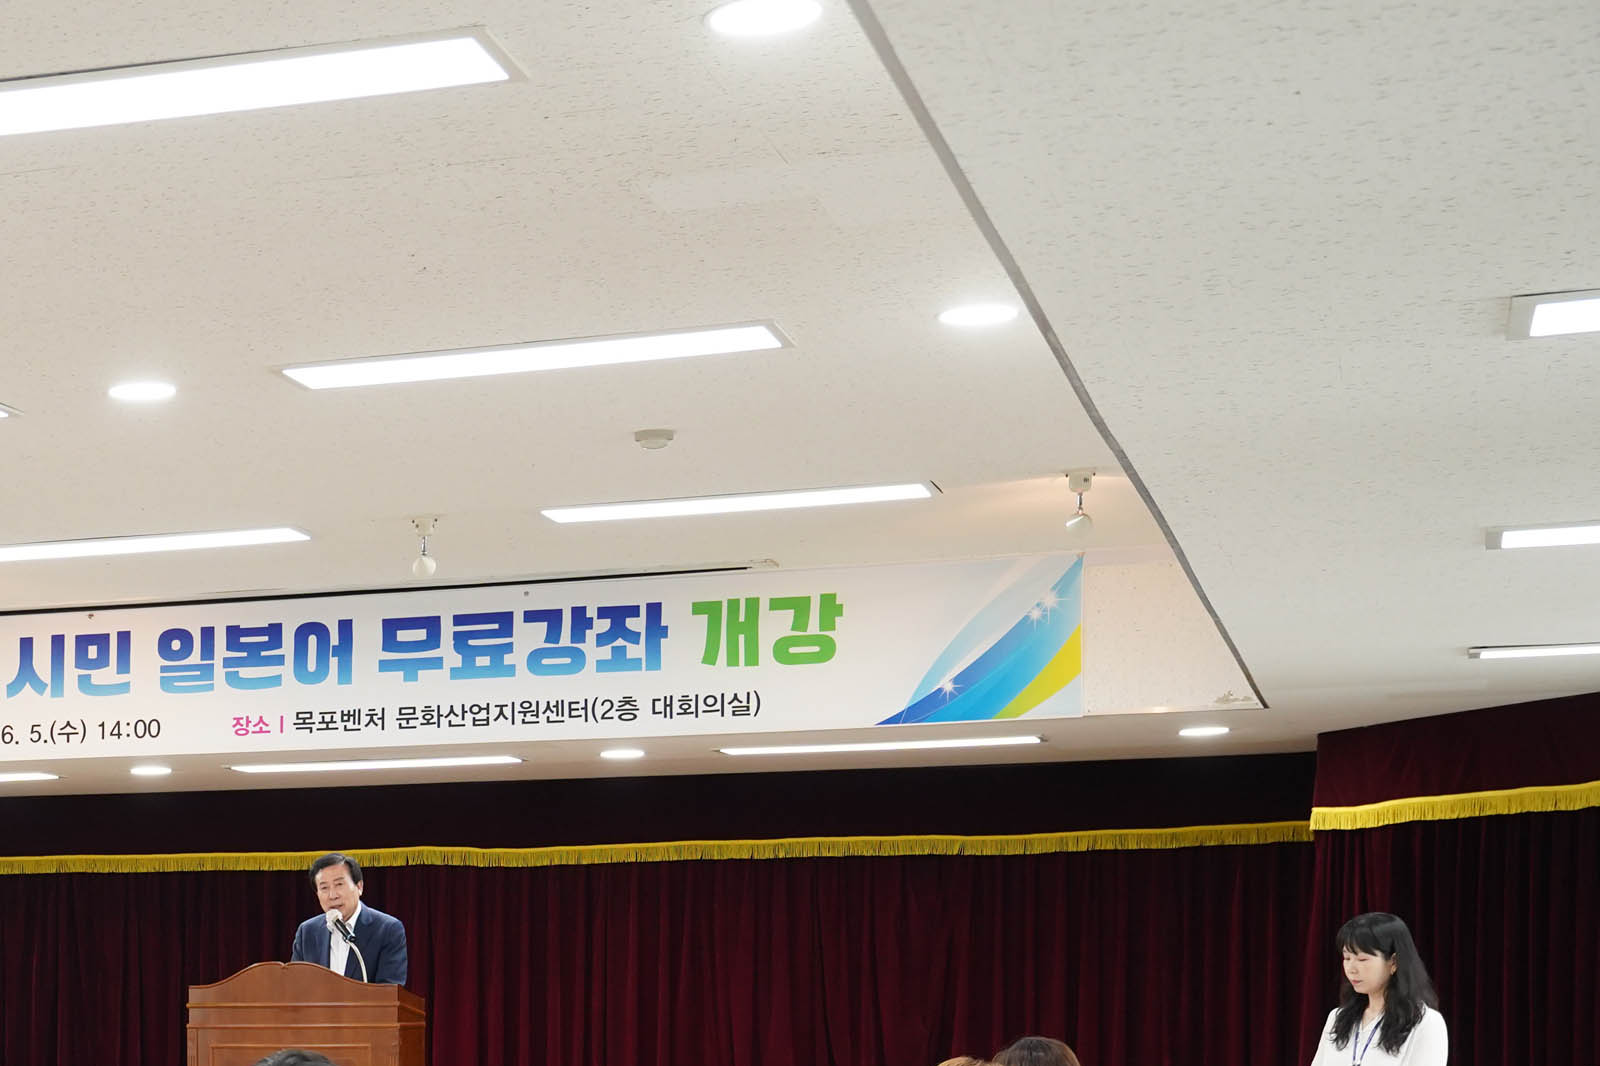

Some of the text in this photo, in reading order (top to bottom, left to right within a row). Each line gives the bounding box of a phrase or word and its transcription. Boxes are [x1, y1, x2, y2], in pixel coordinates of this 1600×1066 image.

[5, 628, 132, 699] 시민
[156, 618, 353, 694] 일본어
[378, 601, 669, 683] 무료강좌
[691, 592, 844, 669] 개강
[0, 724, 20, 746] 6.
[98, 718, 161, 740] 14:00
[231, 715, 271, 736] 장소
[292, 706, 386, 734] 목포벤처
[651, 690, 761, 719] 대회의실)
